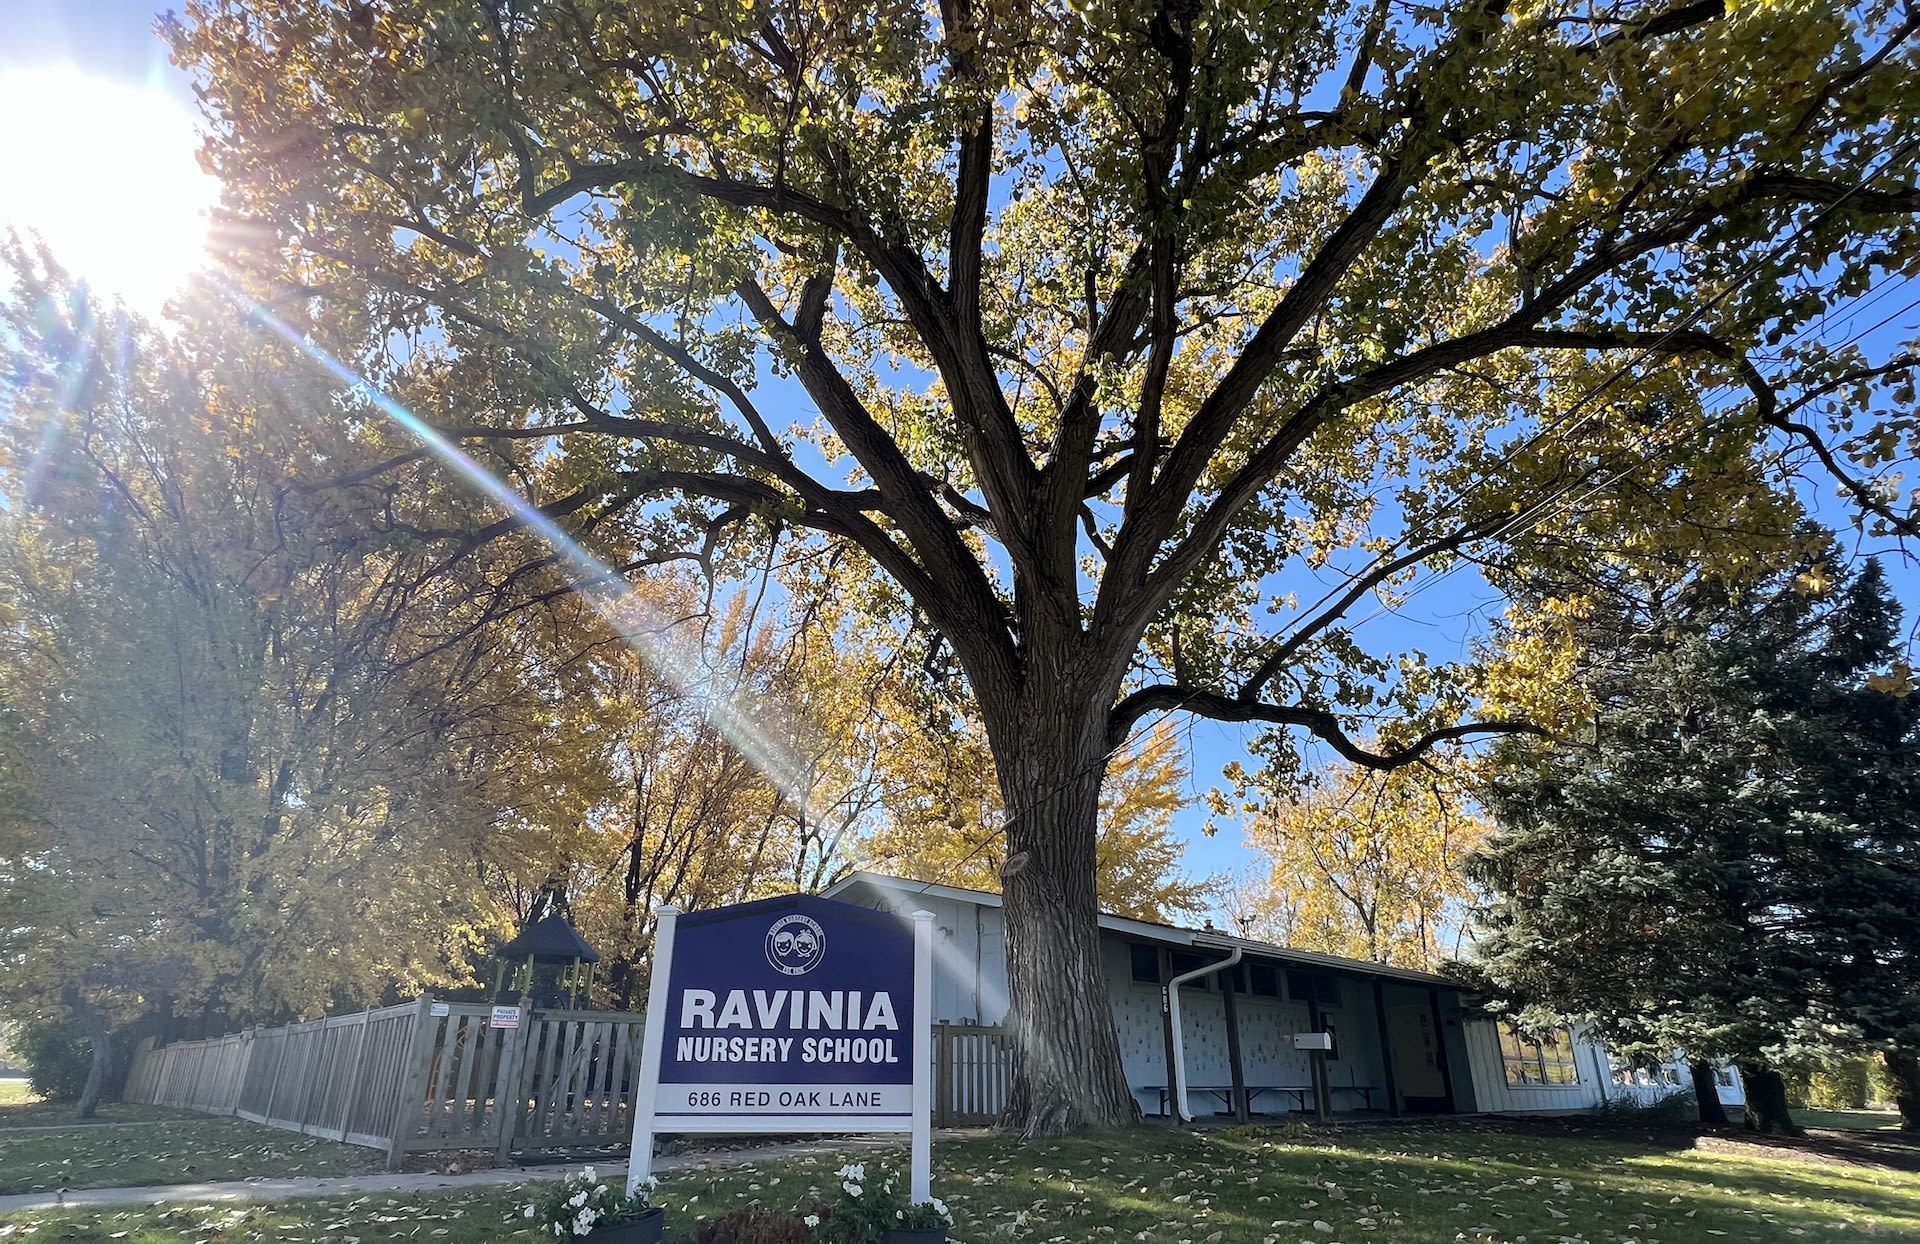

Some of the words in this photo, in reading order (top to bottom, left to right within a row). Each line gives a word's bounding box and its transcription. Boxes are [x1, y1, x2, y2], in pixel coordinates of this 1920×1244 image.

[680, 989, 899, 1031] RAVINIA
[676, 1037, 794, 1062] NURSERY
[801, 1037, 899, 1063] SCHOOL
[688, 1092, 721, 1107] 686
[730, 1092, 771, 1107] RED
[779, 1092, 821, 1107] OAK
[830, 1092, 881, 1107] LANE
